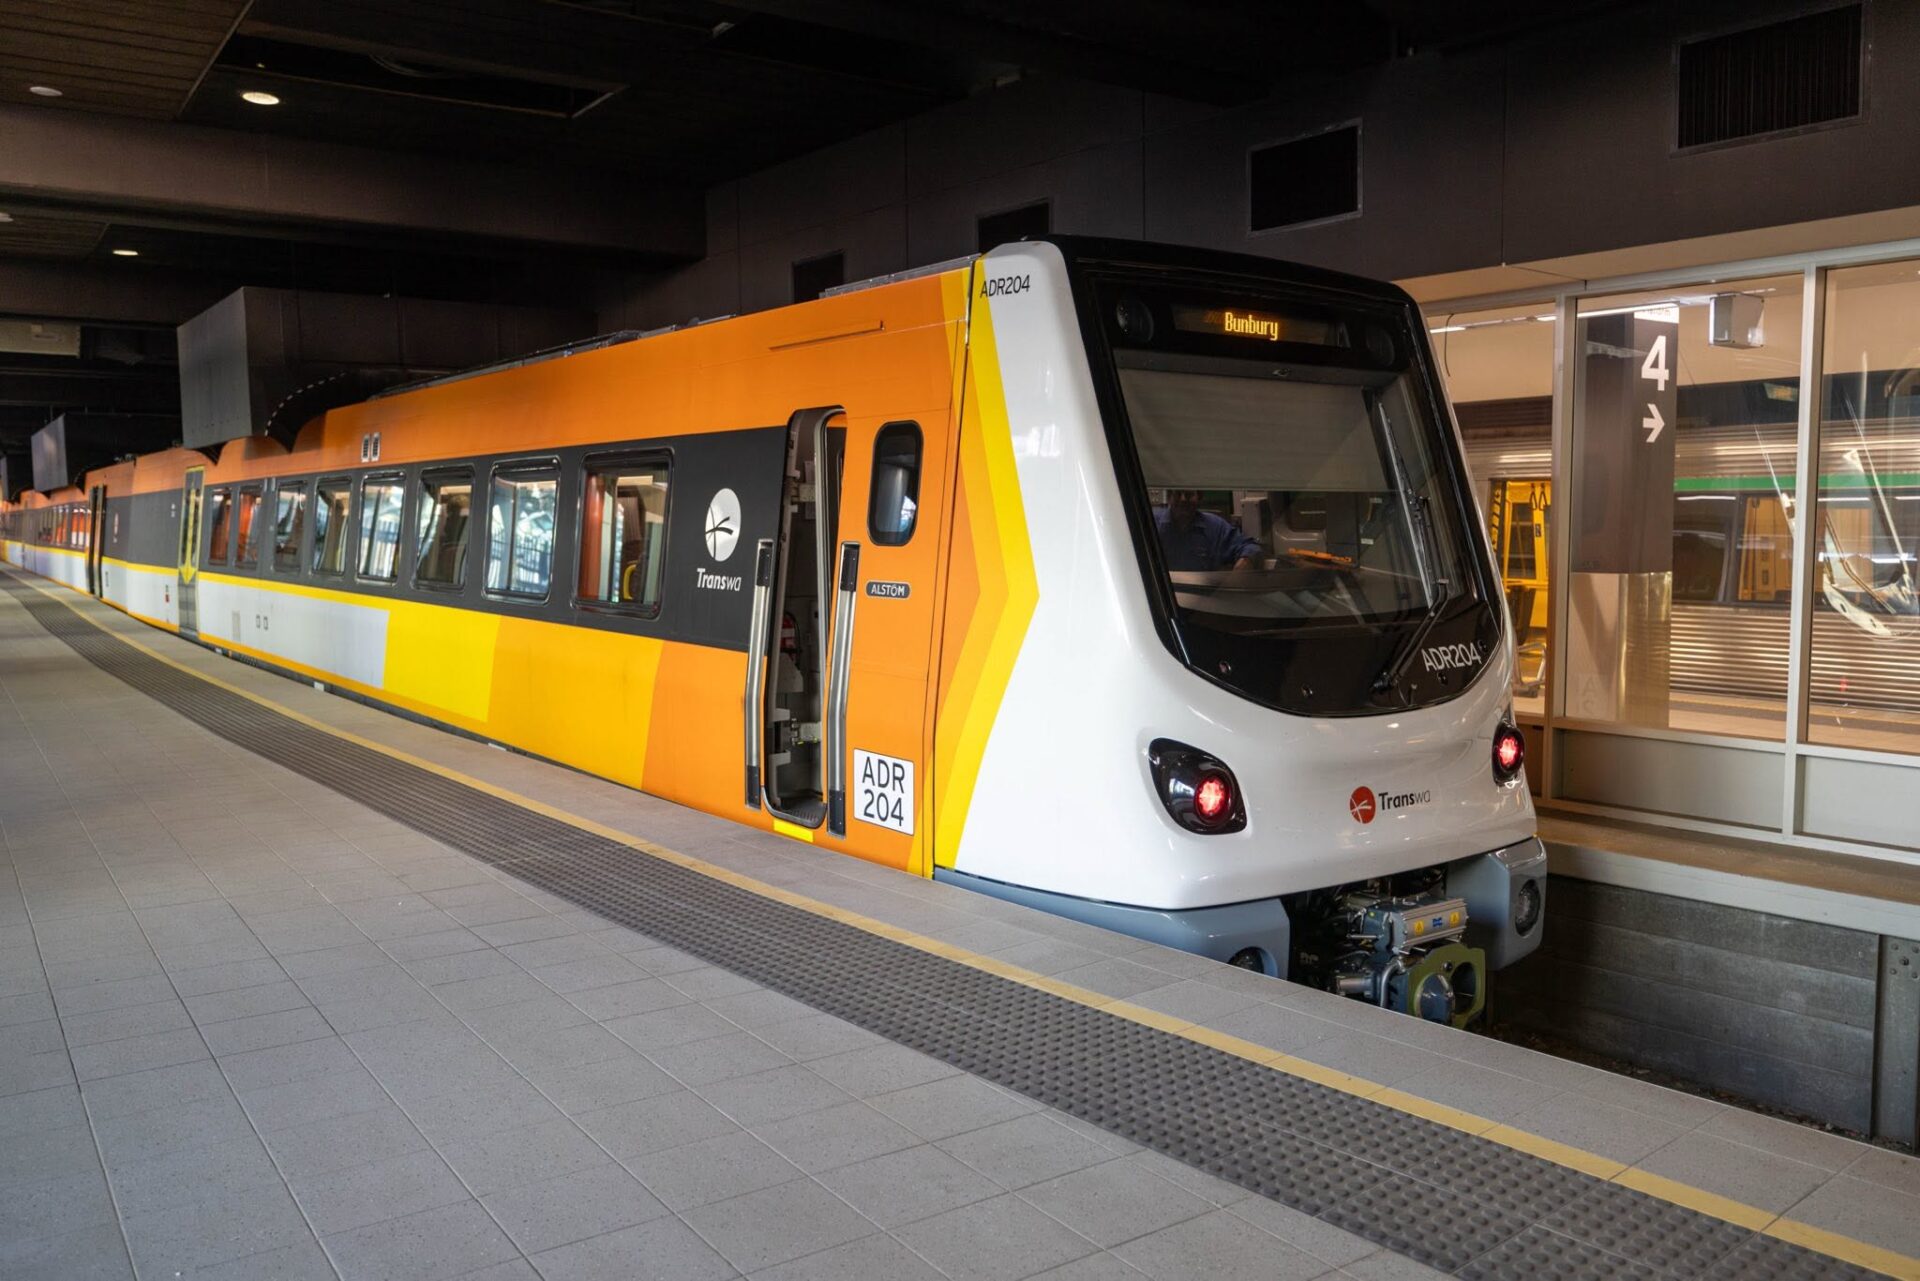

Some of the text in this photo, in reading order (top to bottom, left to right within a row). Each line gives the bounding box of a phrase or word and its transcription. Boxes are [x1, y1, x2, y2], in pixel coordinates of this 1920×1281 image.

[980, 274, 1030, 298] ADR204
[1224, 311, 1278, 341] Bunbury
[1641, 335, 1669, 391] 4
[696, 567, 742, 592] Transwa
[870, 583, 905, 597] ALSTOM
[1421, 642, 1482, 672] ADR204
[862, 756, 905, 794] ADR
[863, 788, 904, 827] 204
[1378, 790, 1431, 811] Transwa
